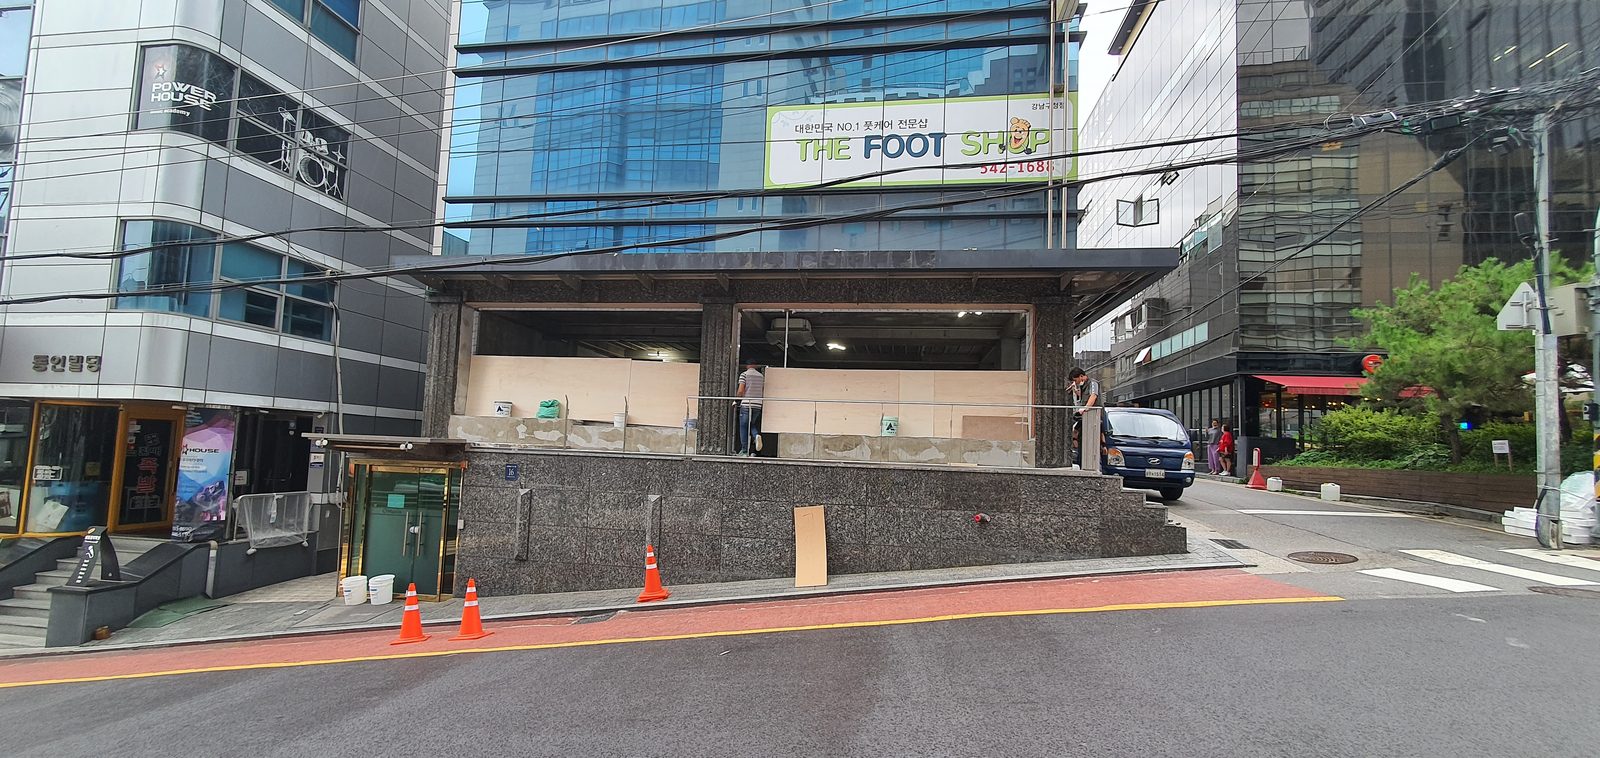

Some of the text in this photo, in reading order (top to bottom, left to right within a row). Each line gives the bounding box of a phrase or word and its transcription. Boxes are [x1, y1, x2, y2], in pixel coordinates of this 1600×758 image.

[151, 91, 212, 111] HOUSE
[152, 81, 217, 104] POWER
[795, 123, 833, 133] 대한민국
[837, 122, 859, 132] NO.1
[864, 120, 893, 131] 풋케어
[796, 126, 1051, 162] THE FOOT SHOP
[980, 160, 1055, 175] 542-1688
[508, 468, 515, 476] 16
